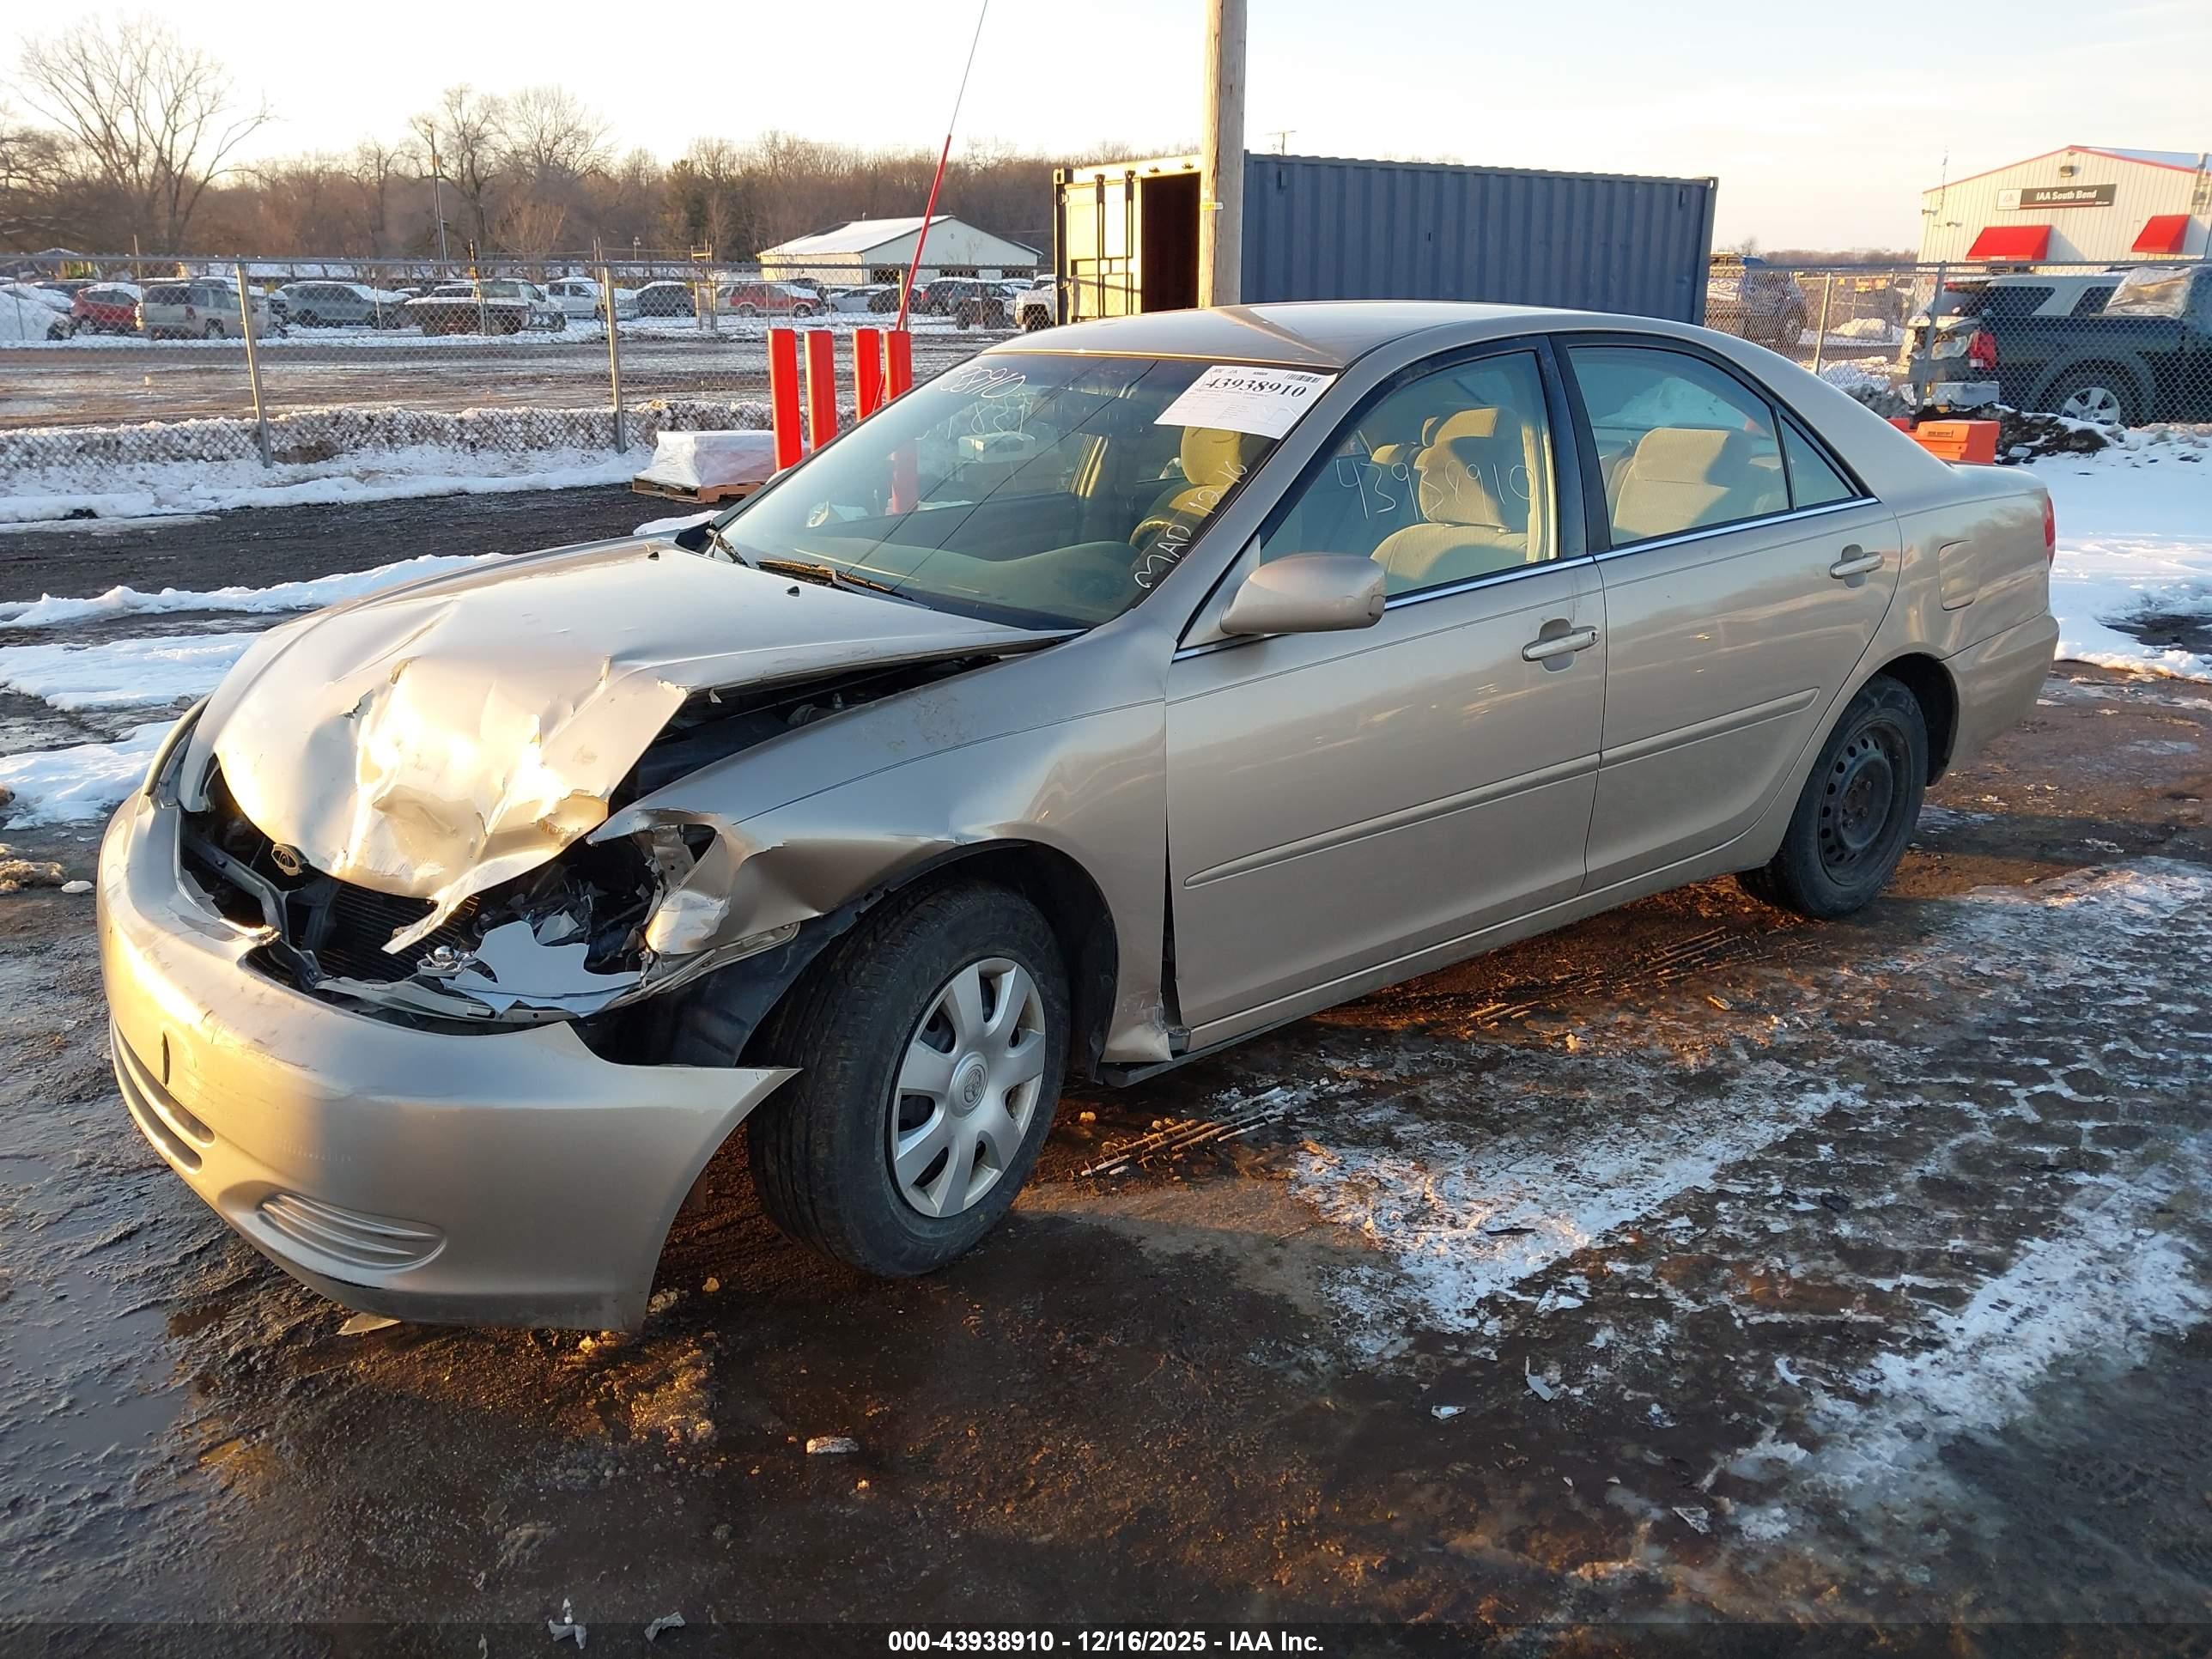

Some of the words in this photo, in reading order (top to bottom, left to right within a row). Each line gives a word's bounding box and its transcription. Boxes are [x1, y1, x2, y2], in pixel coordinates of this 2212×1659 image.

[2035, 191, 2051, 201] IAA
[2051, 191, 2075, 200] South
[2075, 189, 2098, 199] Bend
[1206, 376, 1308, 398] 43938910
[1133, 524, 1192, 588] MAD
